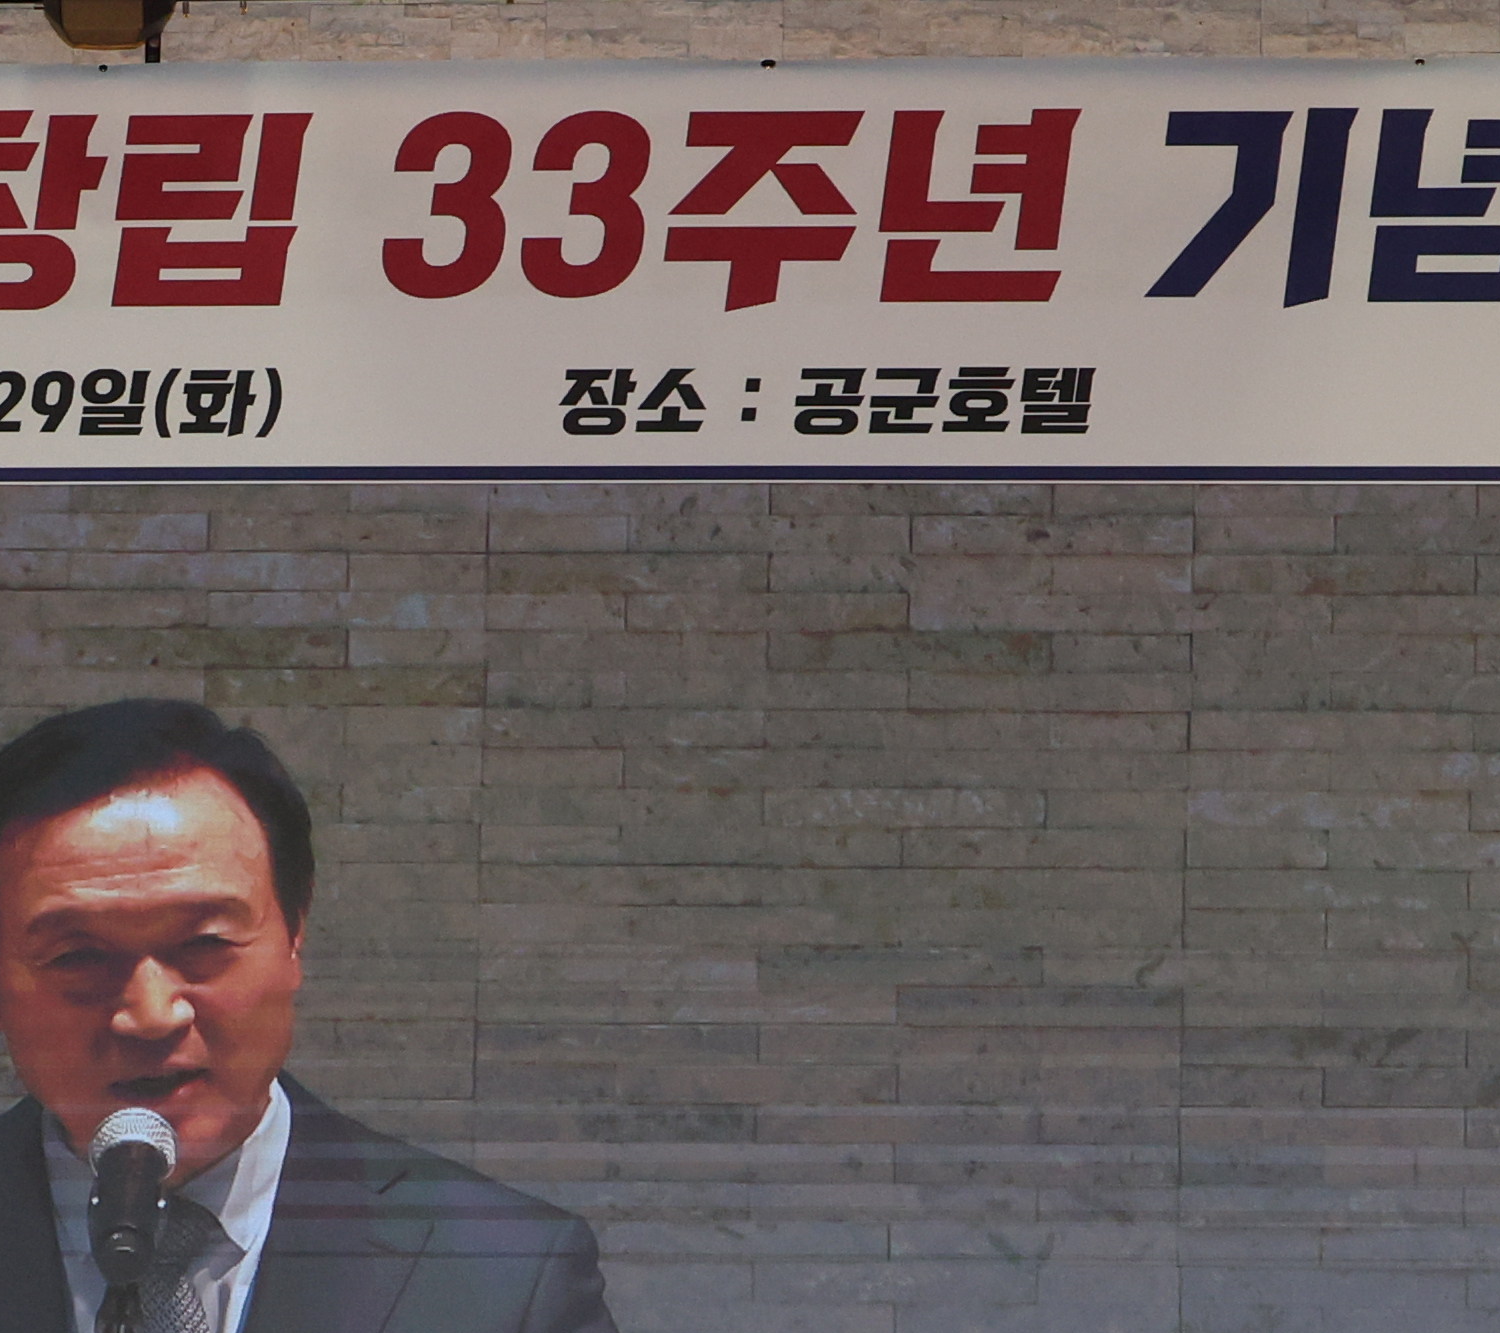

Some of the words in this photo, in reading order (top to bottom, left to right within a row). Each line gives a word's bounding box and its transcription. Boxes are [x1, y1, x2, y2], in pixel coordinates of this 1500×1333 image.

[381, 108, 1083, 312] 33주년
[559, 367, 707, 436] 장소
[794, 366, 1097, 436] 공군호텔
